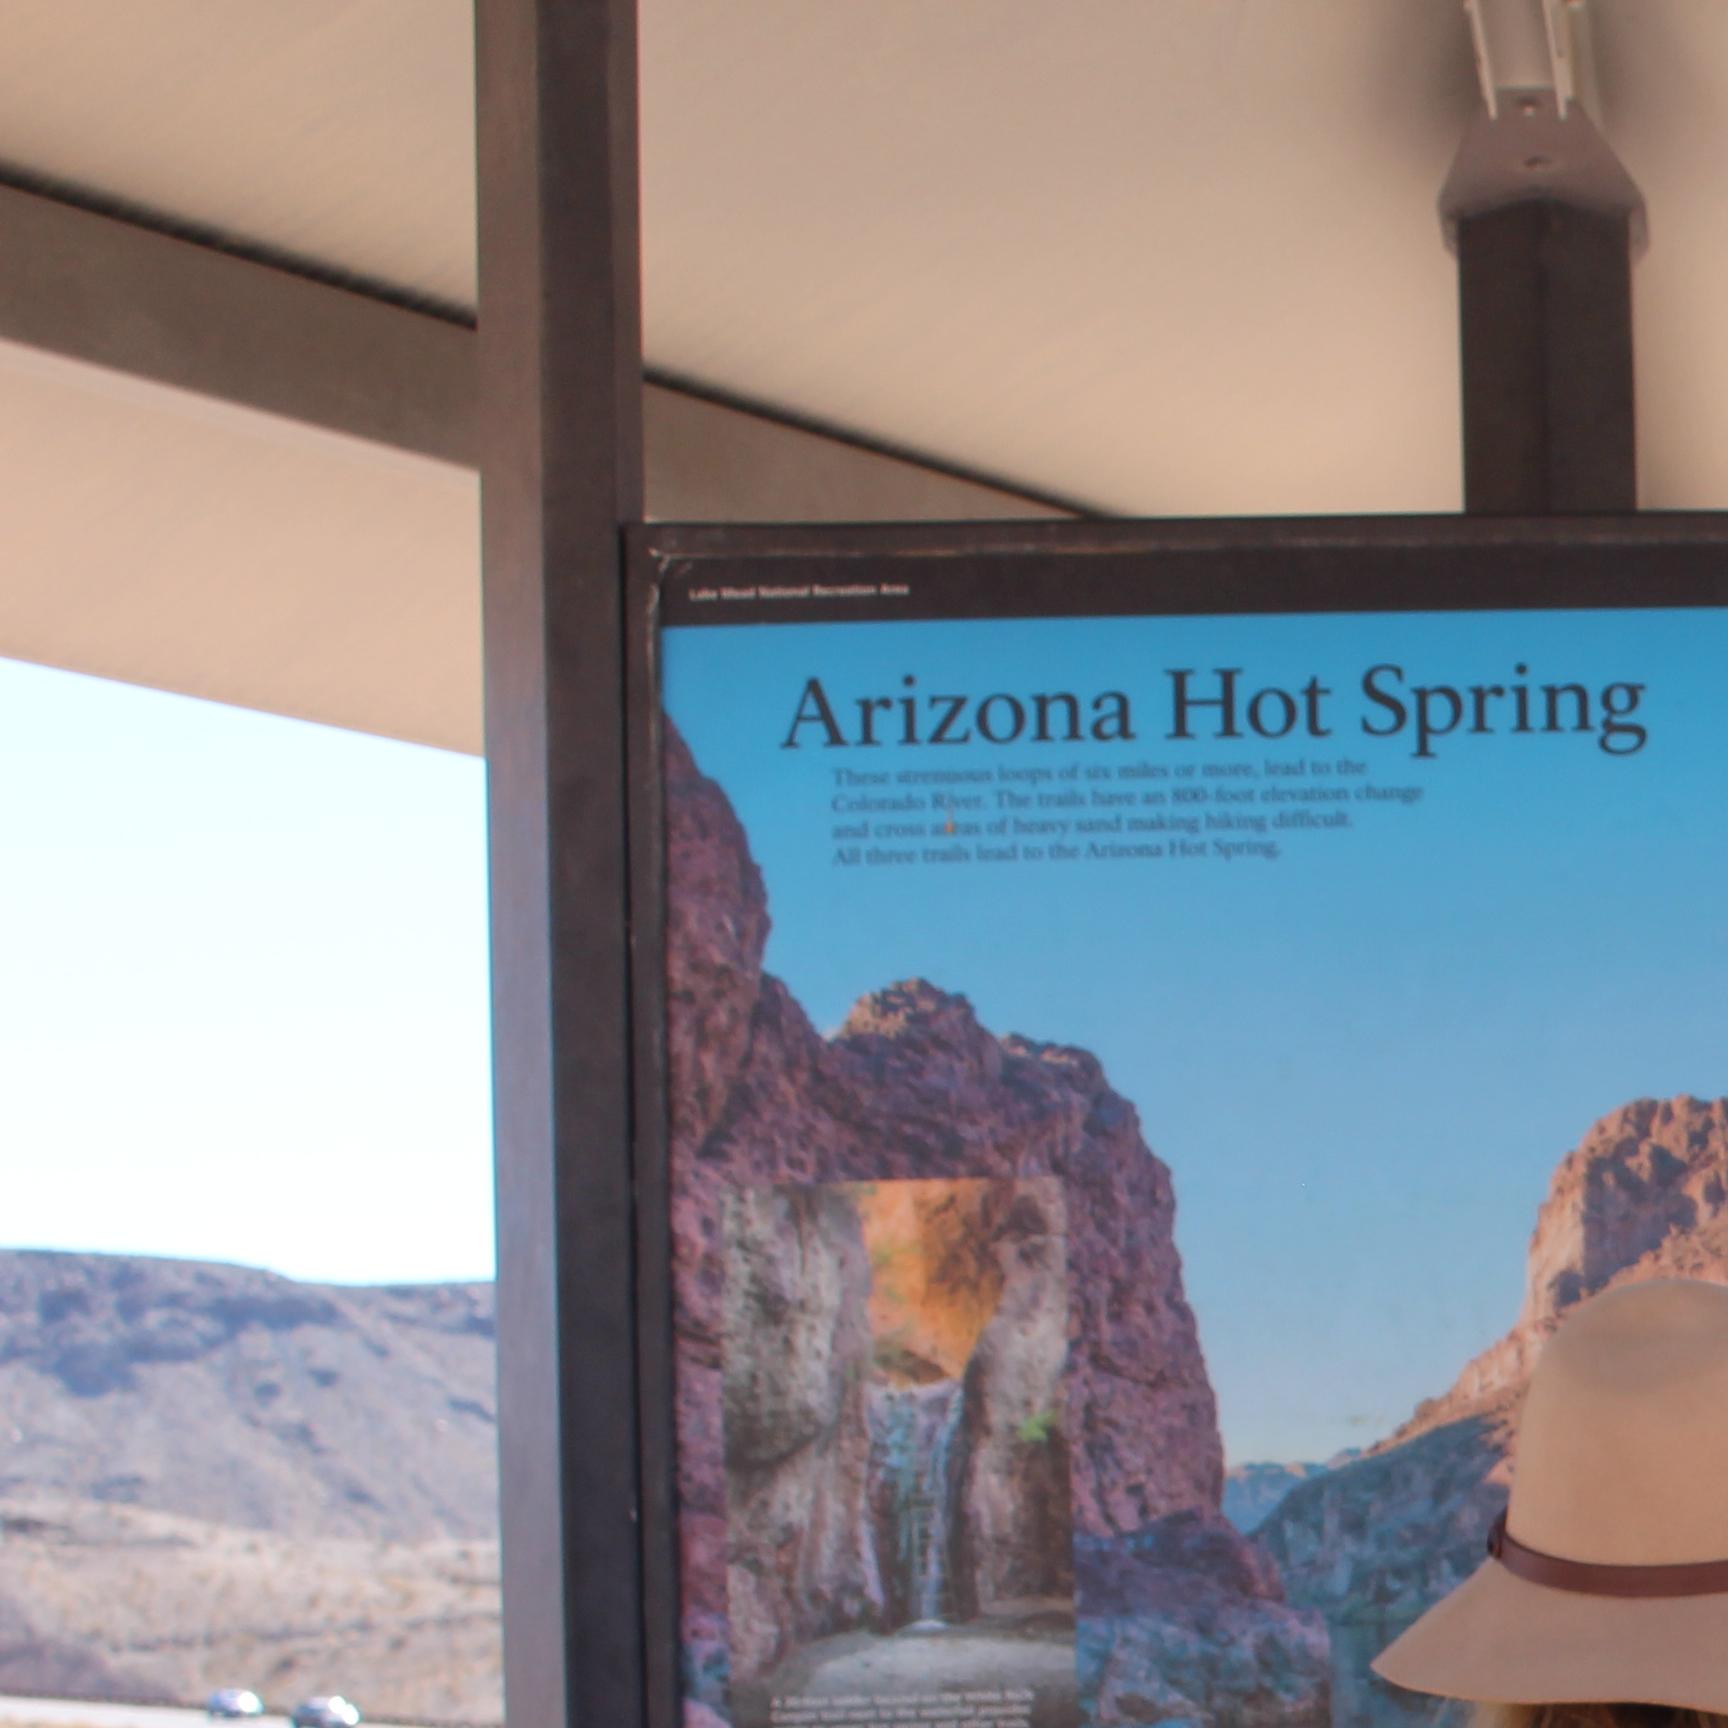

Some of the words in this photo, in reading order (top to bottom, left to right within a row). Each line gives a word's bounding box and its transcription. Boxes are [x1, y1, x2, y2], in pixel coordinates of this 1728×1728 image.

[780, 675, 1136, 751] Arizona
[1164, 667, 1333, 742] Hot
[1361, 663, 1648, 758] Spring
[834, 768, 889, 787] These
[998, 766, 1052, 787] loops
[1058, 763, 1079, 780] of
[1086, 764, 1111, 780] six
[1118, 762, 1169, 779] miles
[1175, 764, 1195, 778] or
[1264, 758, 1305, 776] lead
[1312, 760, 1331, 775] to
[1337, 758, 1367, 775] the
[832, 794, 923, 813] Colorado
[931, 792, 985, 811] River.
[996, 790, 1032, 808] The
[1038, 788, 1086, 807] trails
[1091, 787, 1138, 806] have
[1143, 791, 1166, 805] an
[1261, 783, 1348, 802] elevation
[1353, 780, 1424, 804] change
[832, 820, 869, 839] and
[875, 823, 926, 837] cross
[987, 816, 1009, 835] of
[1013, 814, 1070, 838] heavy
[1076, 813, 1122, 832] sand
[1128, 811, 1200, 833] making
[1205, 809, 1268, 832] hiking
[1272, 808, 1355, 829] difficult.
[834, 849, 861, 866] All
[866, 847, 915, 865] three
[923, 845, 972, 863] trails
[977, 844, 1019, 862] lead
[1024, 846, 1043, 861] to
[1049, 843, 1081, 860] the
[1087, 840, 1163, 858] Arizona
[1169, 838, 1208, 857] Hot
[1213, 837, 1282, 862] Spring.
